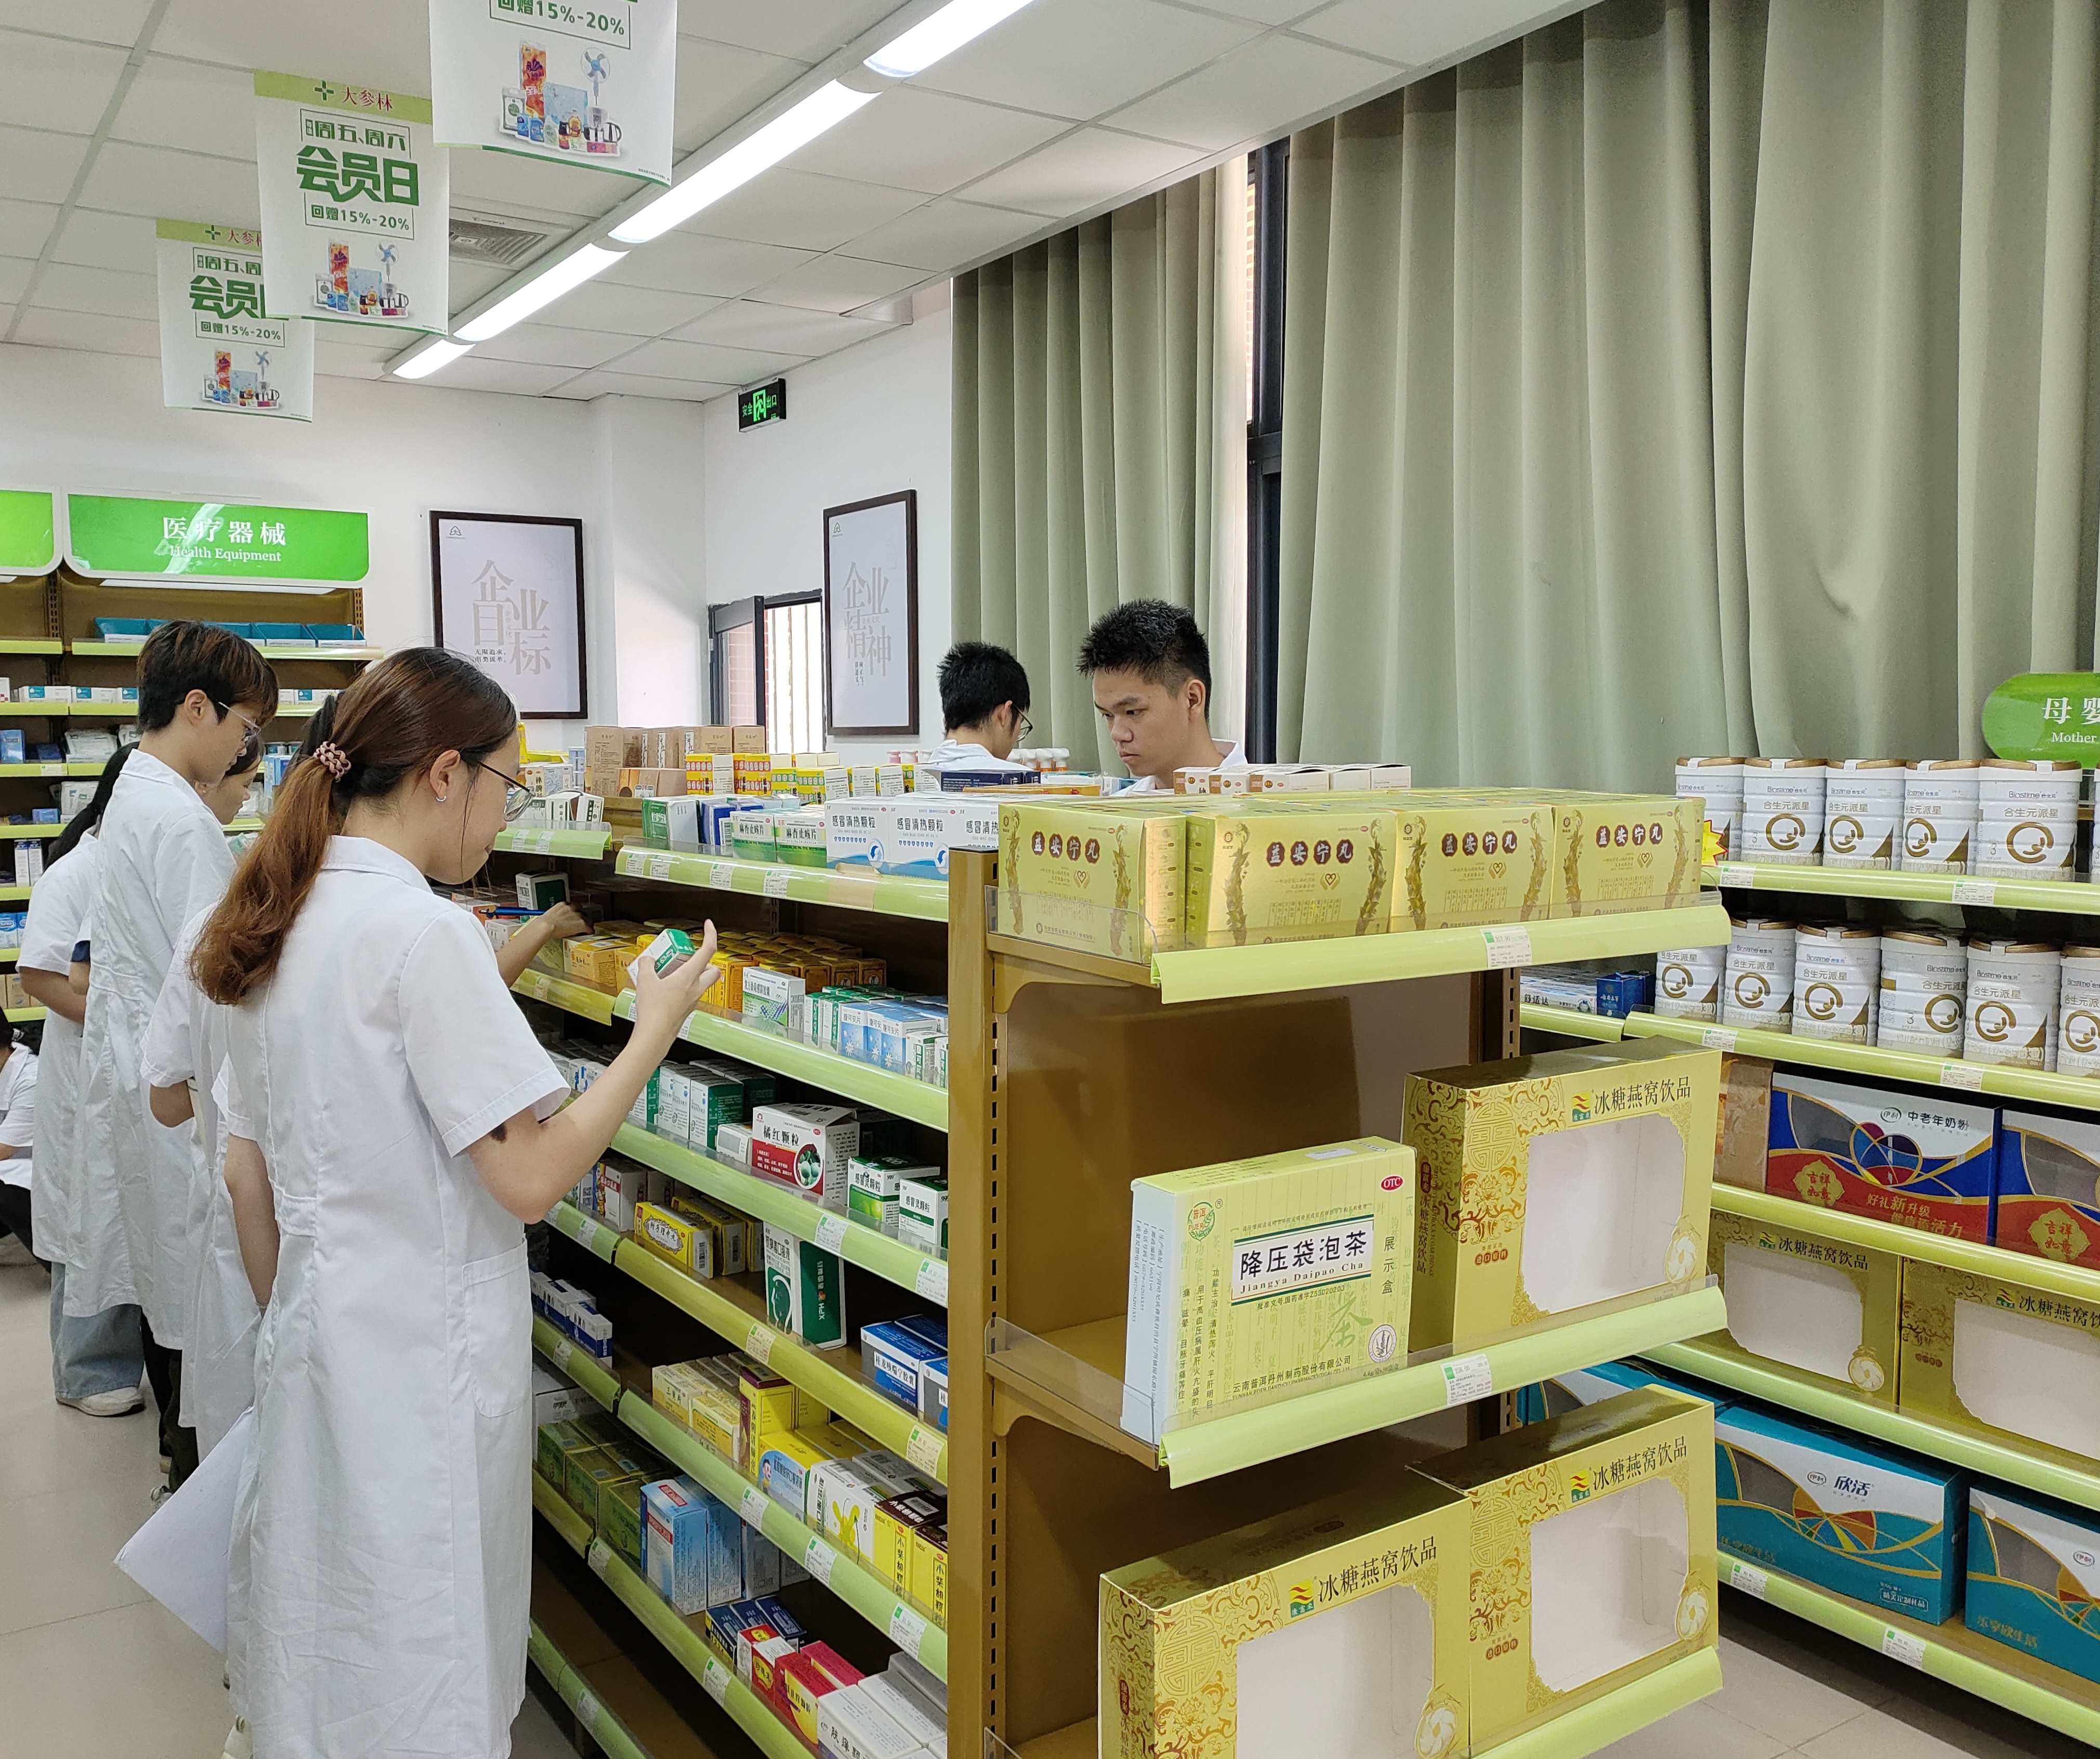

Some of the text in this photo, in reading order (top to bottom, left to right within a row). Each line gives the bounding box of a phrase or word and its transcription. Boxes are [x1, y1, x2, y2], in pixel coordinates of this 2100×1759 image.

[342, 87, 393, 112] 大参林
[296, 145, 419, 206] 会员日
[311, 204, 409, 230] 回赠15%-20%
[189, 275, 266, 320] 会员
[742, 402, 753, 418] 安全
[766, 395, 777, 408] 出口
[163, 516, 286, 545] 医疗器械
[170, 545, 281, 562] Health Equipment
[471, 559, 549, 631] 企业
[843, 561, 890, 618] 企业
[472, 602, 550, 675] 目标
[844, 609, 892, 677] 精神
[2041, 697, 2100, 725] 母婴
[2051, 731, 2097, 743] Mother
[1764, 801, 1809, 811] 合生元派星
[2004, 807, 2058, 818] 合生元派星
[832, 815, 876, 829] 感冒清热颗粒
[897, 817, 944, 832] 感冒清热颗粒
[1032, 832, 1099, 861] 益安宁丸
[1442, 831, 1517, 857] 益安宁丸
[1597, 823, 1663, 848] 益安宁丸
[1268, 841, 1352, 865] 益安宁丸
[1990, 843, 1997, 856] 3
[1733, 959, 1775, 970] 合生元派星
[1804, 969, 1848, 981] 合生元派星
[1524, 993, 1550, 1006] 舒适达
[1974, 986, 2022, 999] 合生元派星
[843, 1013, 861, 1025] 腹可安片
[883, 1023, 900, 1036] 腹可安片
[1907, 1013, 1914, 1024] 3
[1594, 1077, 1691, 1115] 冰糖燕窝饮品
[1882, 1110, 1899, 1120] 伊利
[1908, 1111, 1969, 1131] 中老年奶粉
[763, 1124, 799, 1147] 橘红颗粒
[855, 1173, 882, 1193] 感冒灵颗粒
[1383, 1177, 1401, 1188] OTC
[1806, 1171, 1831, 1186] 吉祥
[905, 1195, 930, 1213] 感冒灵颗粒
[1193, 1207, 1206, 1220] 普洱
[1866, 1193, 1930, 1218] 好礼新升级
[1188, 1223, 1204, 1231] PUER
[1416, 1196, 1430, 1275] 冰糖燕窝饮品
[1891, 1212, 1963, 1238] 健康添活力
[2044, 1220, 2073, 1240] 吉祥
[1240, 1230, 1367, 1281] 降压袋泡茶
[1778, 1236, 1868, 1270] 冰糖燕窝饮品
[1381, 1236, 1396, 1295] 展示盒
[1240, 1262, 1363, 1294] Jiangya Daipao Cha
[875, 1354, 914, 1386] 桂龙咳喘宁胶囊
[1232, 1355, 1351, 1393] 云南普洱丹州制药股份有限公司
[1592, 1435, 1687, 1490] 冰糖燕窝饮品
[1809, 1474, 1824, 1484] 伊利
[1833, 1476, 1871, 1497] 欣活
[896, 1537, 904, 1598] 小柴胡颗粒
[1318, 1535, 1437, 1603] 冰糖燕窝饮品
